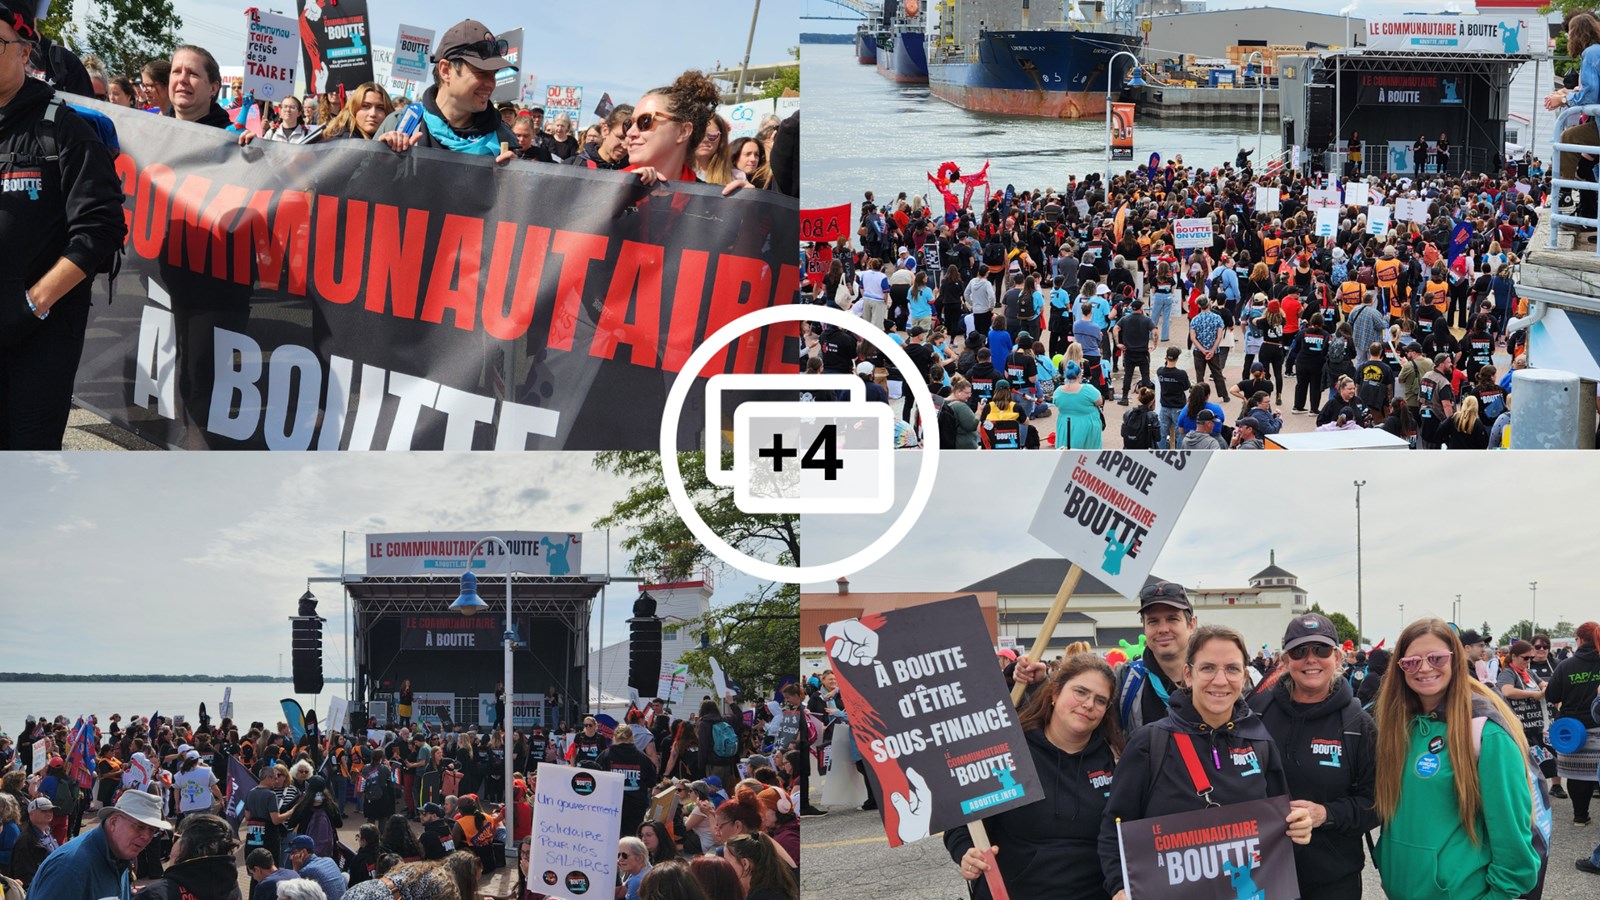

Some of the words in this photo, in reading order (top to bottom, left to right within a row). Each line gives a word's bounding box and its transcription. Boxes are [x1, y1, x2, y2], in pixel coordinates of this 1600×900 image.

[328, 22, 365, 40] BOUTTE
[1370, 22, 1380, 36] LE
[1382, 21, 1457, 36] COMMUNAUTAIRE
[1459, 20, 1465, 36] À
[1468, 24, 1498, 37] BOUTTE
[249, 42, 277, 55] refuse
[401, 41, 430, 55] BOUTTE
[247, 61, 286, 80] TAIRE
[393, 79, 415, 90] BOUTE
[1362, 76, 1372, 86] LE
[1373, 75, 1437, 87] COMMUNAUTAIRE
[1379, 88, 1385, 103] À
[1387, 90, 1420, 103] BOUTTE
[3, 178, 42, 192] BOUTTE
[134, 276, 176, 420] À
[1078, 454, 1087, 466] LE
[1096, 450, 1157, 496] APPUIE
[1064, 480, 1073, 494] À
[1072, 466, 1157, 528] COMMUNAUTAIRE
[1063, 486, 1148, 559] BOUTTE
[370, 543, 382, 558] LE
[500, 541, 539, 557] BOUTTE
[407, 617, 417, 629] LE
[419, 617, 495, 629] COMMUNAUTAIRE
[426, 630, 432, 647] À
[436, 633, 475, 647] BOUTTE
[874, 659, 892, 688] À
[892, 646, 968, 683] BOUTTE
[871, 700, 1012, 763] SOUS-FINANCÉ
[947, 743, 1011, 768] COMMUNAUTAIRE
[1312, 744, 1342, 756] BOUTTE
[955, 752, 1017, 786] BOUTTE
[969, 788, 1017, 810] ABOUTTE.INFO
[1152, 824, 1161, 835] LE
[1154, 819, 1259, 851] COMMUNAUTAIRE
[1158, 853, 1165, 867] À
[1166, 838, 1261, 886] BOUTTE
